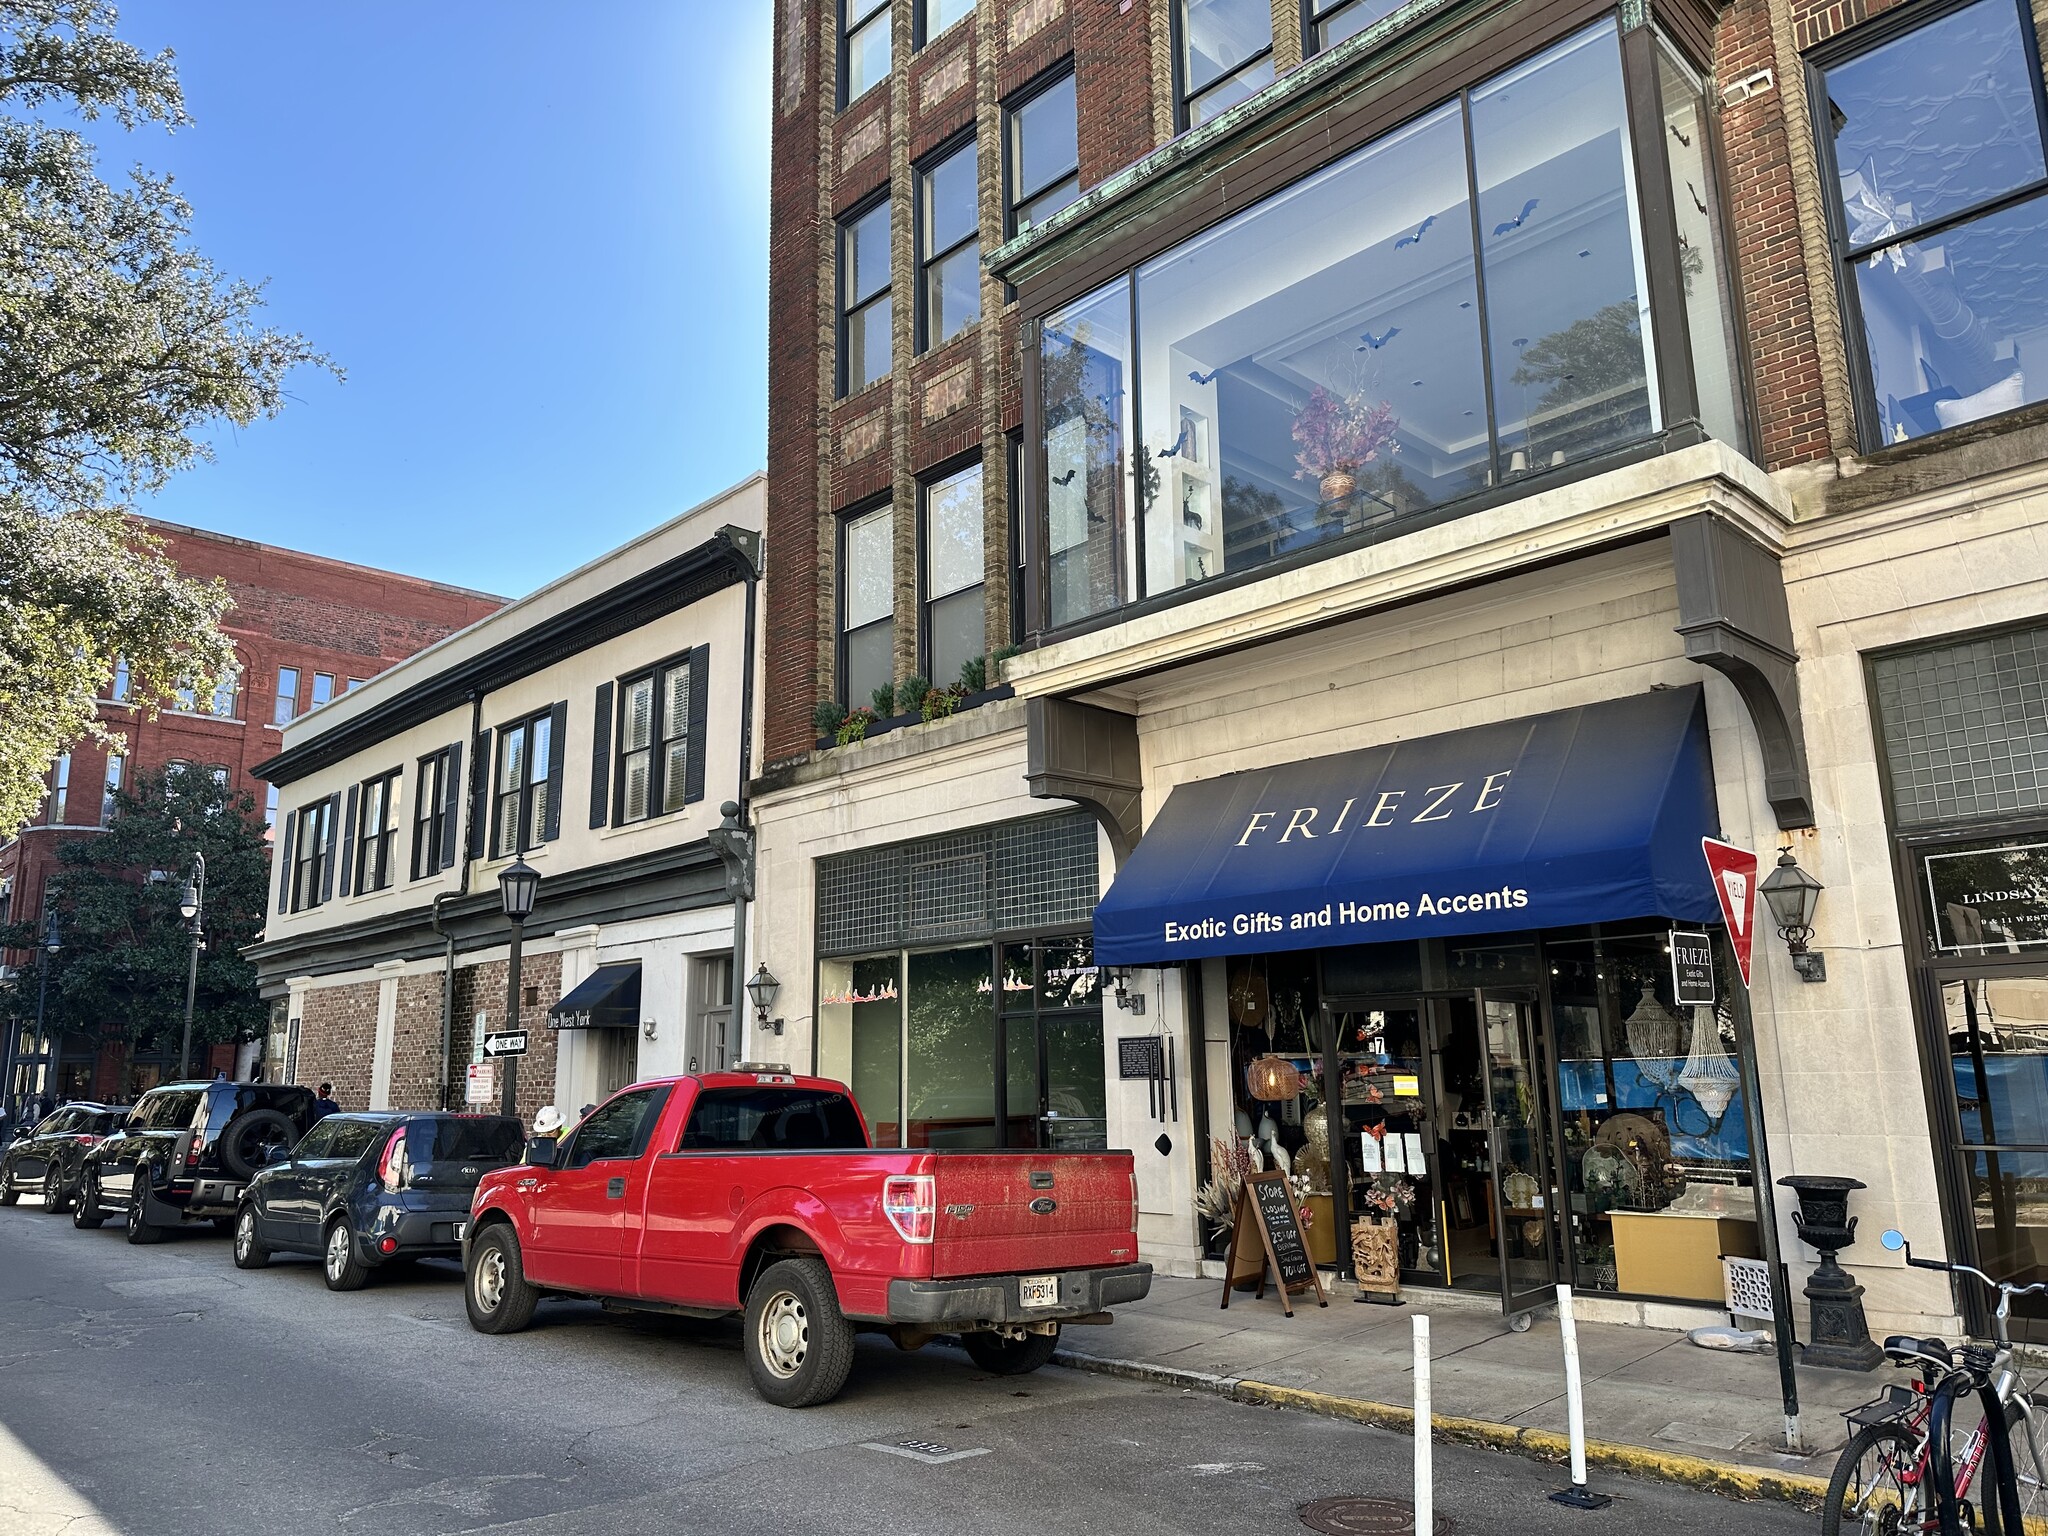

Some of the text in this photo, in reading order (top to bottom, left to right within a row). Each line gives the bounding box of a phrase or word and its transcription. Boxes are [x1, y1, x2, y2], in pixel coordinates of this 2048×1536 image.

[1234, 769, 1512, 847] FRIEZE
[1727, 880, 1744, 899] YIELD
[1963, 888, 2041, 904] LINDSAY
[1165, 885, 1529, 943] Exotic Gifts and Home Accents
[1676, 946, 1710, 966] FRIEZE
[548, 1009, 590, 1028] One West York
[495, 1038, 523, 1050] ONE WAY
[1376, 1038, 1383, 1054] 7
[1258, 1184, 1284, 1201] STORE
[1261, 1203, 1289, 1215] CLOSING
[1023, 1284, 1054, 1300] RXF5314
[900, 1440, 949, 1453] 3330
